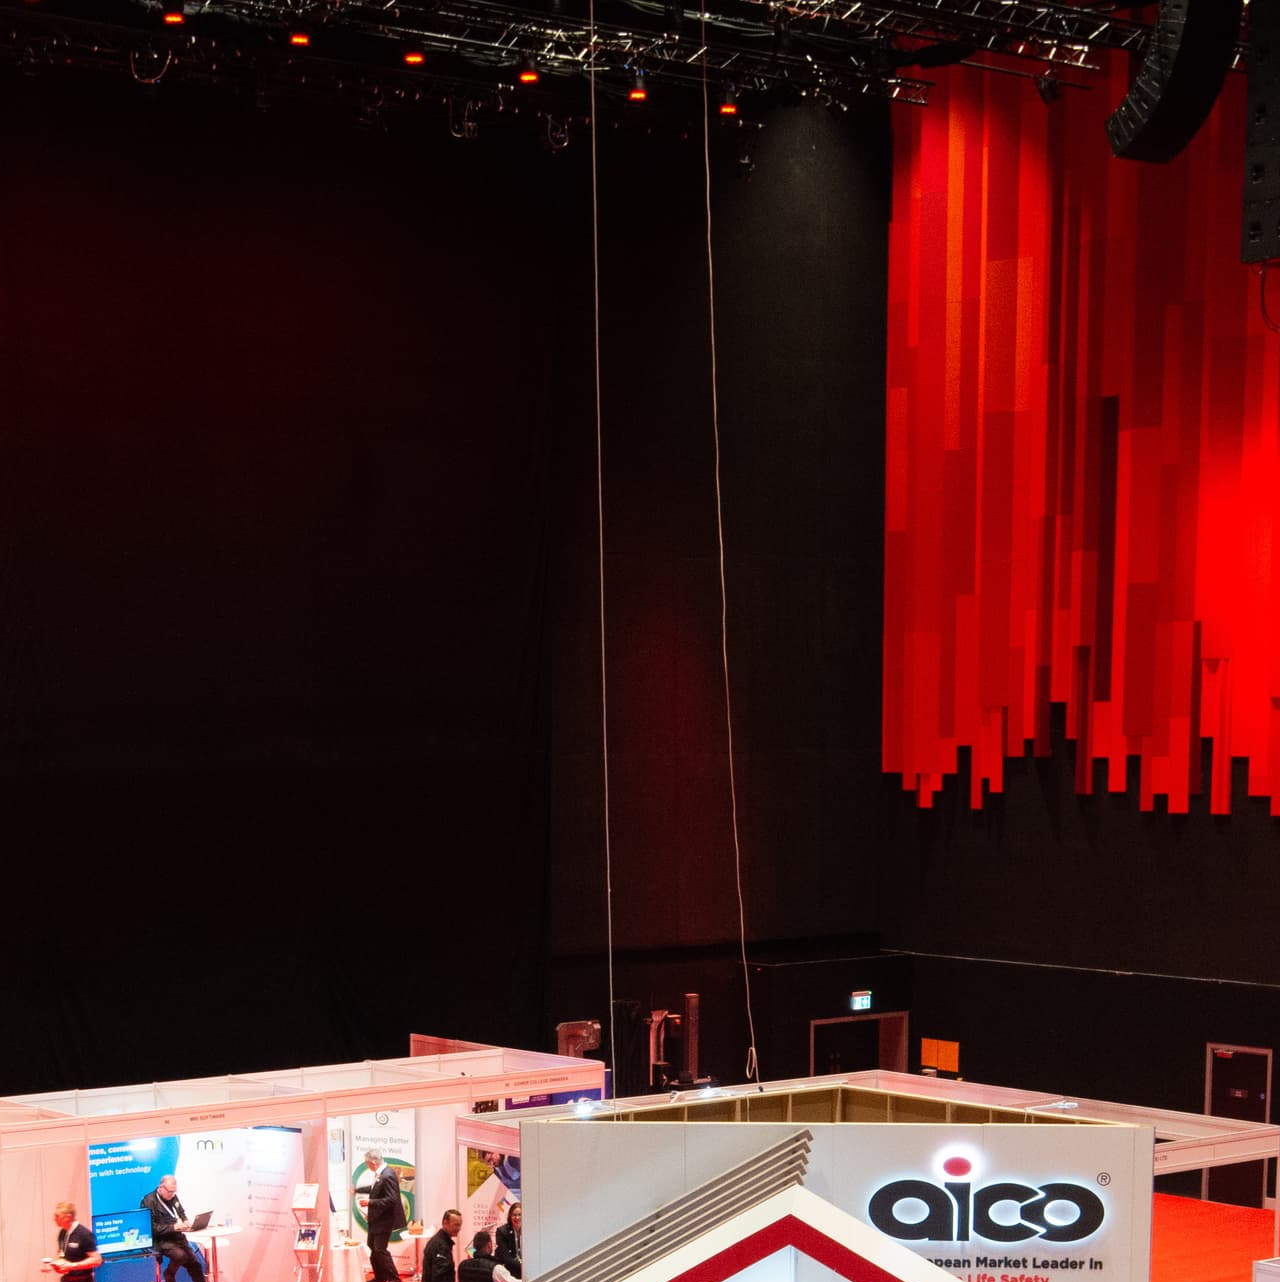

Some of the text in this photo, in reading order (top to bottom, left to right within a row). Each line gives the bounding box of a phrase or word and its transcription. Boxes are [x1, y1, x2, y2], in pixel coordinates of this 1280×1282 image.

[355, 1135, 409, 1146] Managing Better
[99, 1164, 152, 1177] with technology
[869, 1157, 1105, 1243] aico
[976, 1257, 1085, 1270] Market Leader
